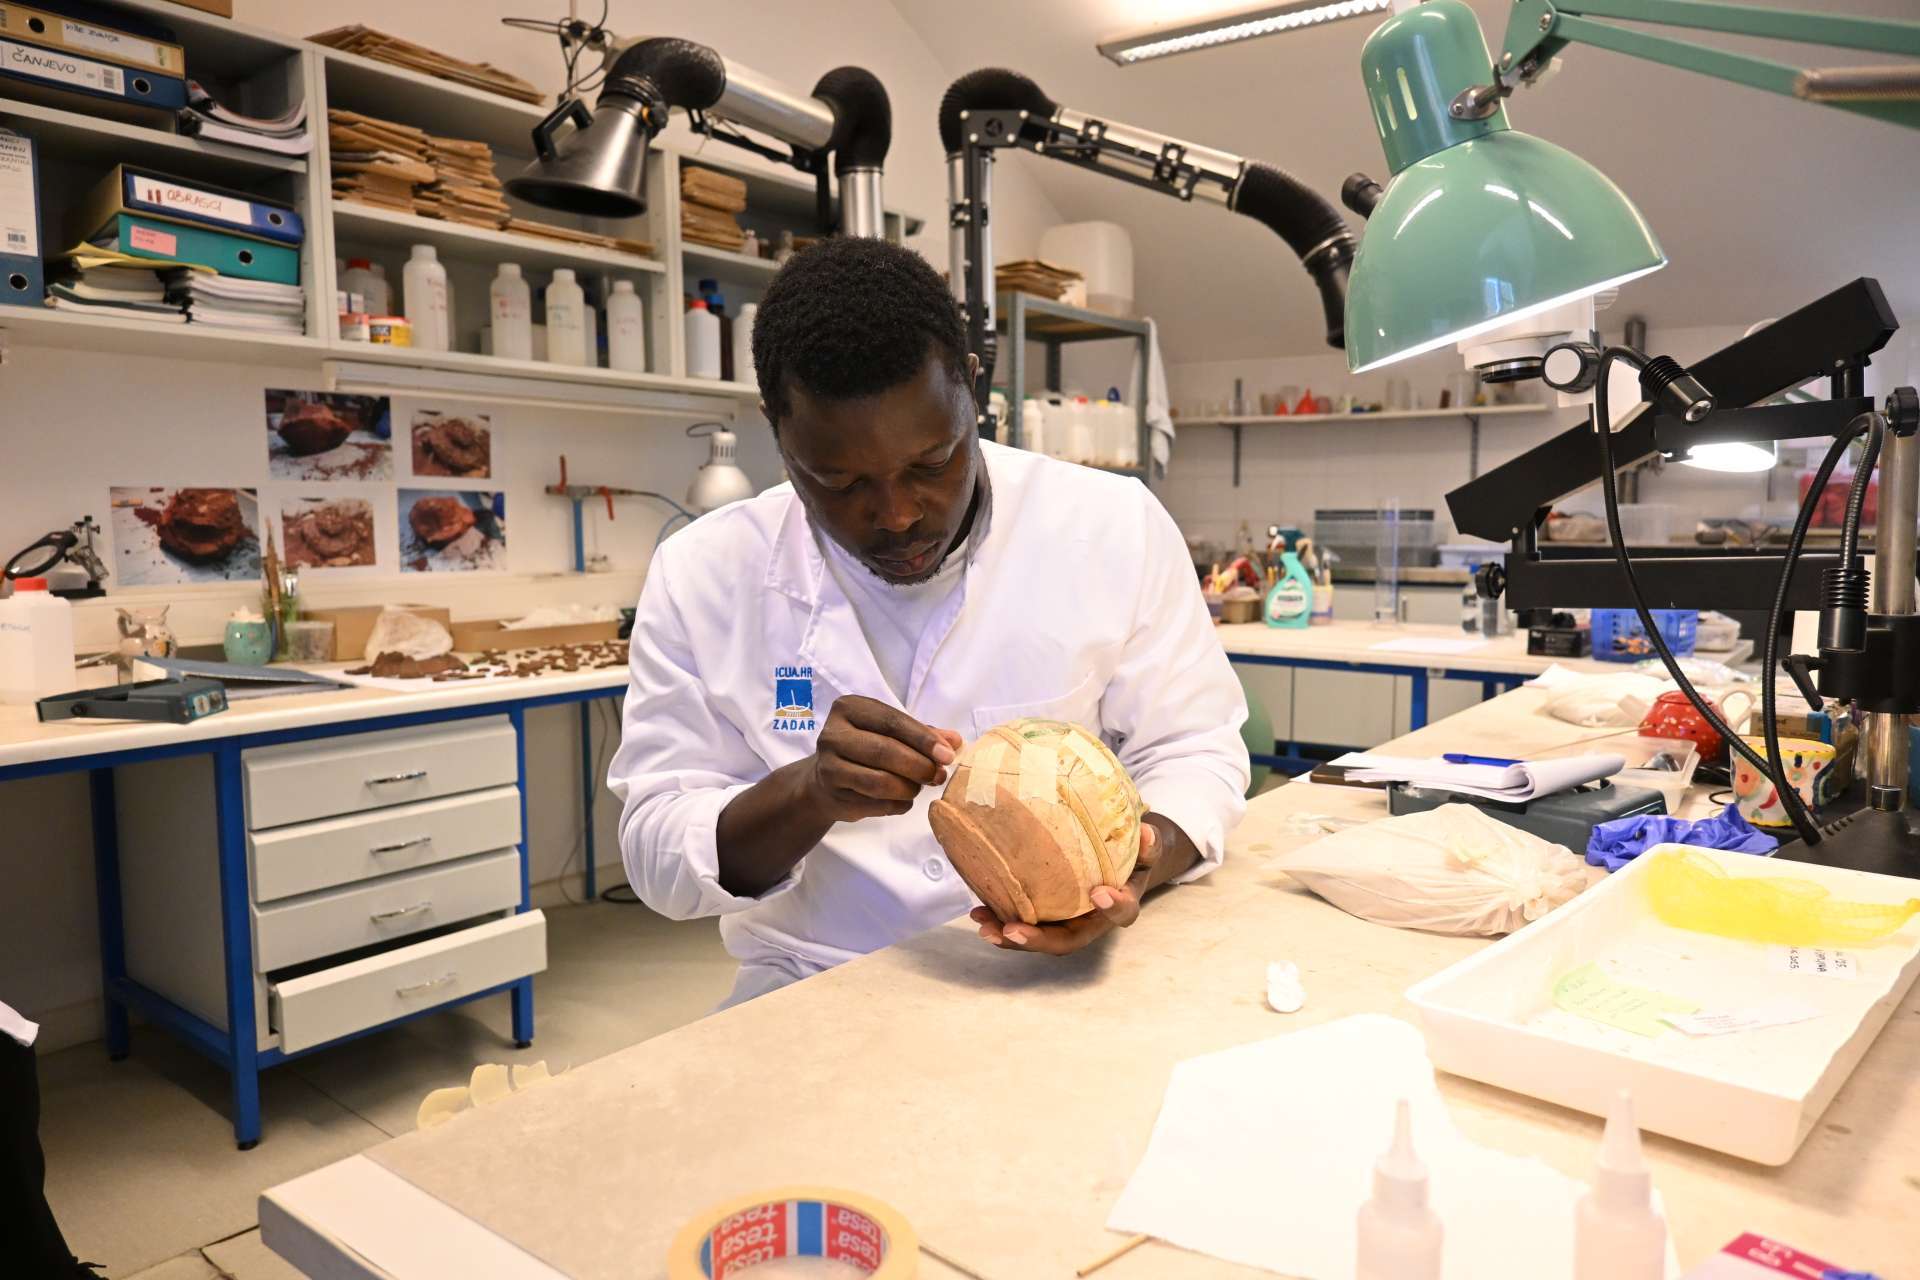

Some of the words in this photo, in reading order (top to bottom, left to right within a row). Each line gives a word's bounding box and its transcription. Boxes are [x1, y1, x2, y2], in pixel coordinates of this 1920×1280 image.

[12, 47, 76, 74] ČANJEVO
[773, 719, 816, 731] ZADAR
[720, 1223, 779, 1259] tesa
[838, 1209, 879, 1245] tesa
[838, 1231, 879, 1266] tesa
